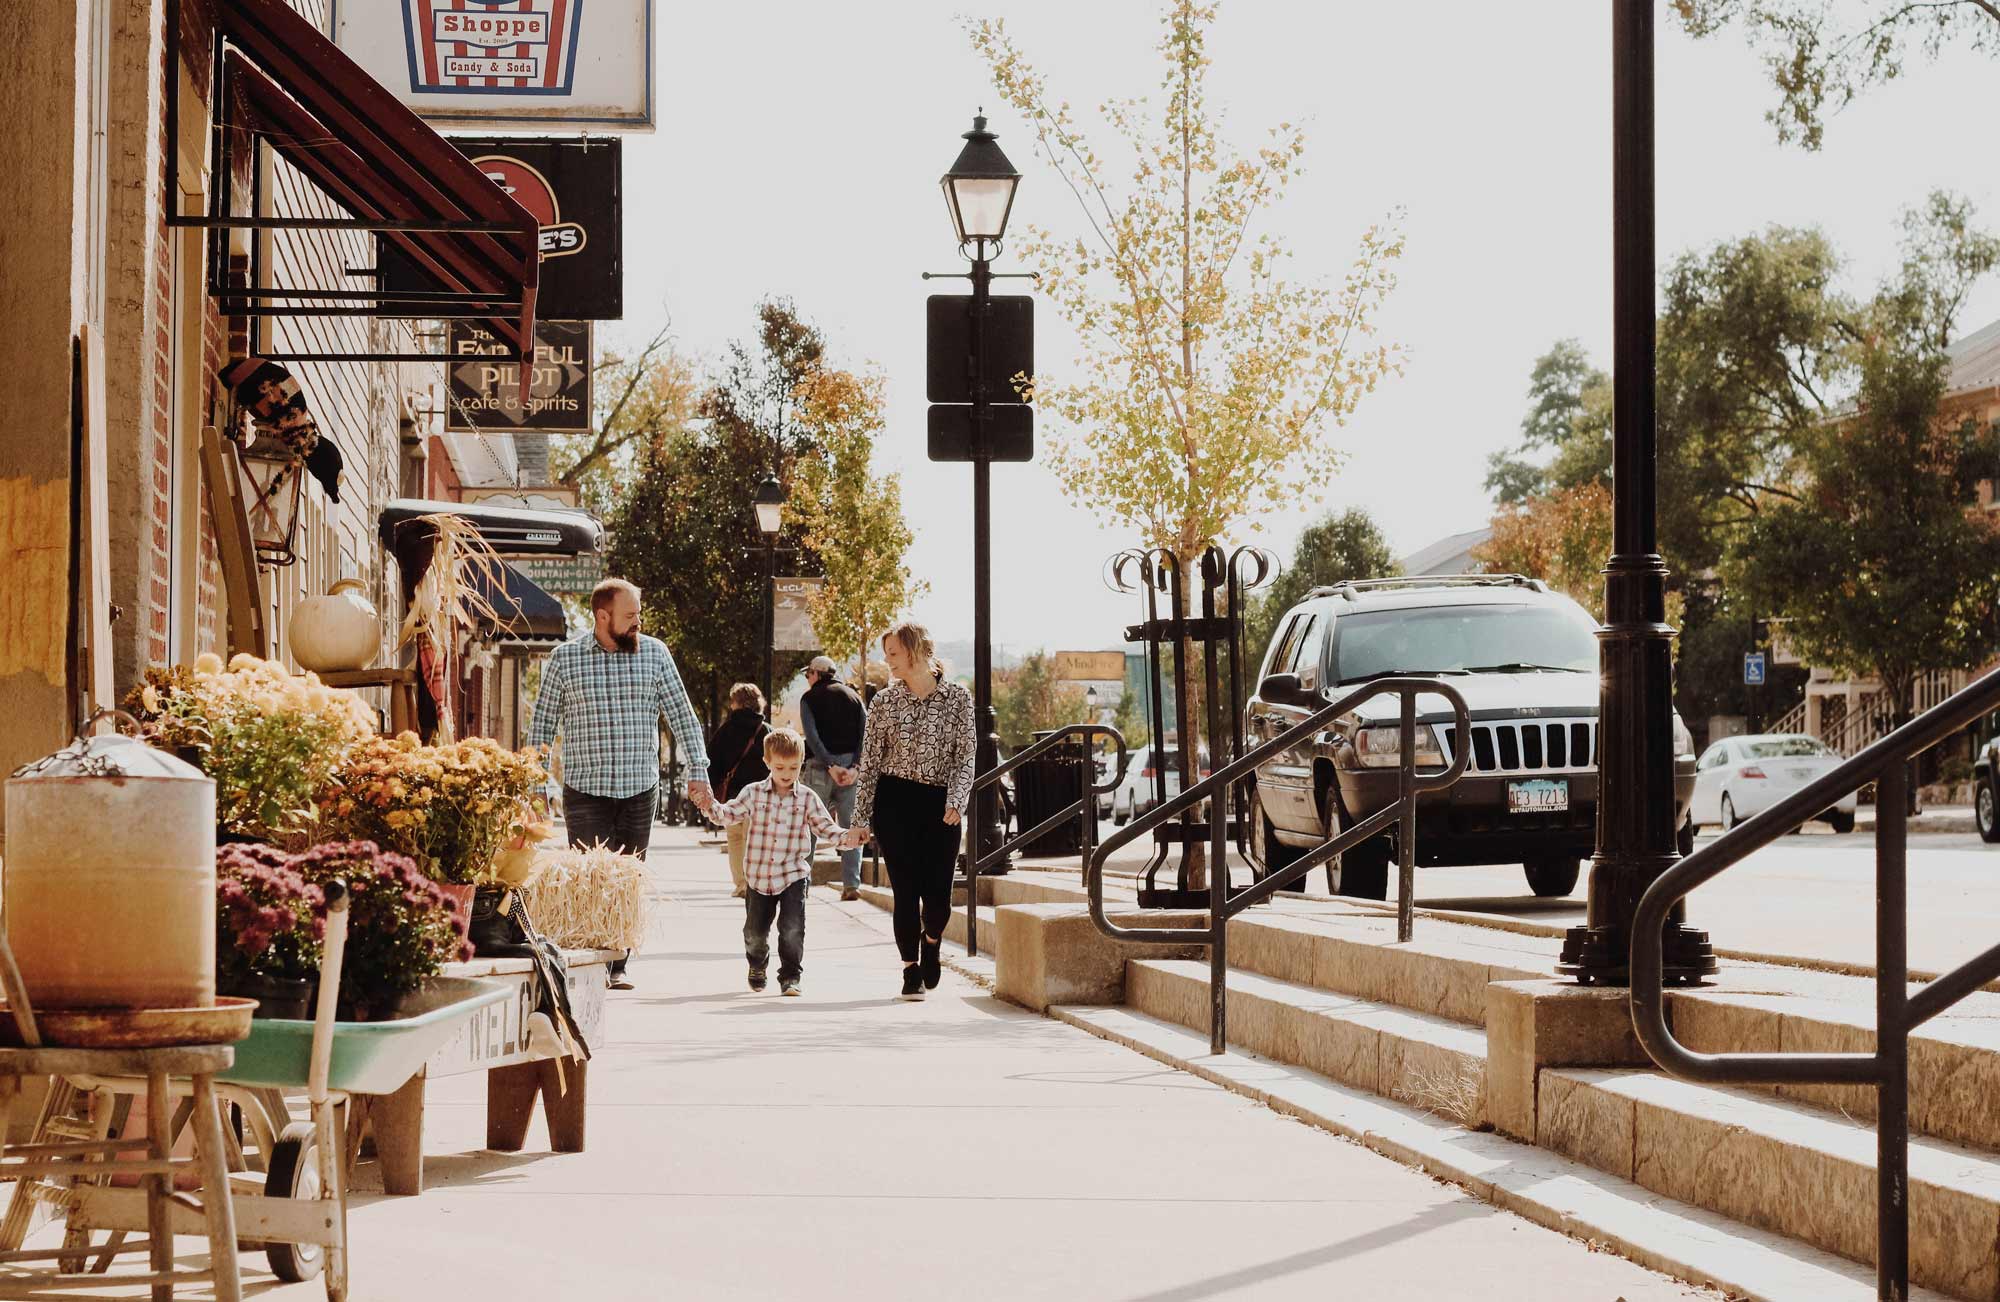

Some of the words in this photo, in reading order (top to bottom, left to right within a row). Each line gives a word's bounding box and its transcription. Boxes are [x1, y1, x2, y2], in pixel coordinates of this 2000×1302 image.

[444, 15, 541, 36] Shoppe
[450, 61, 482, 73] Candy
[490, 62, 499, 72] &
[507, 62, 531, 73] Soda
[538, 229, 578, 251] E'S
[457, 340, 583, 365] FAITFUL
[460, 391, 500, 410] cafe
[505, 396, 518, 410] &
[522, 394, 579, 416] spirits
[1509, 790, 1530, 807] AE3
[1538, 788, 1567, 806] 7213
